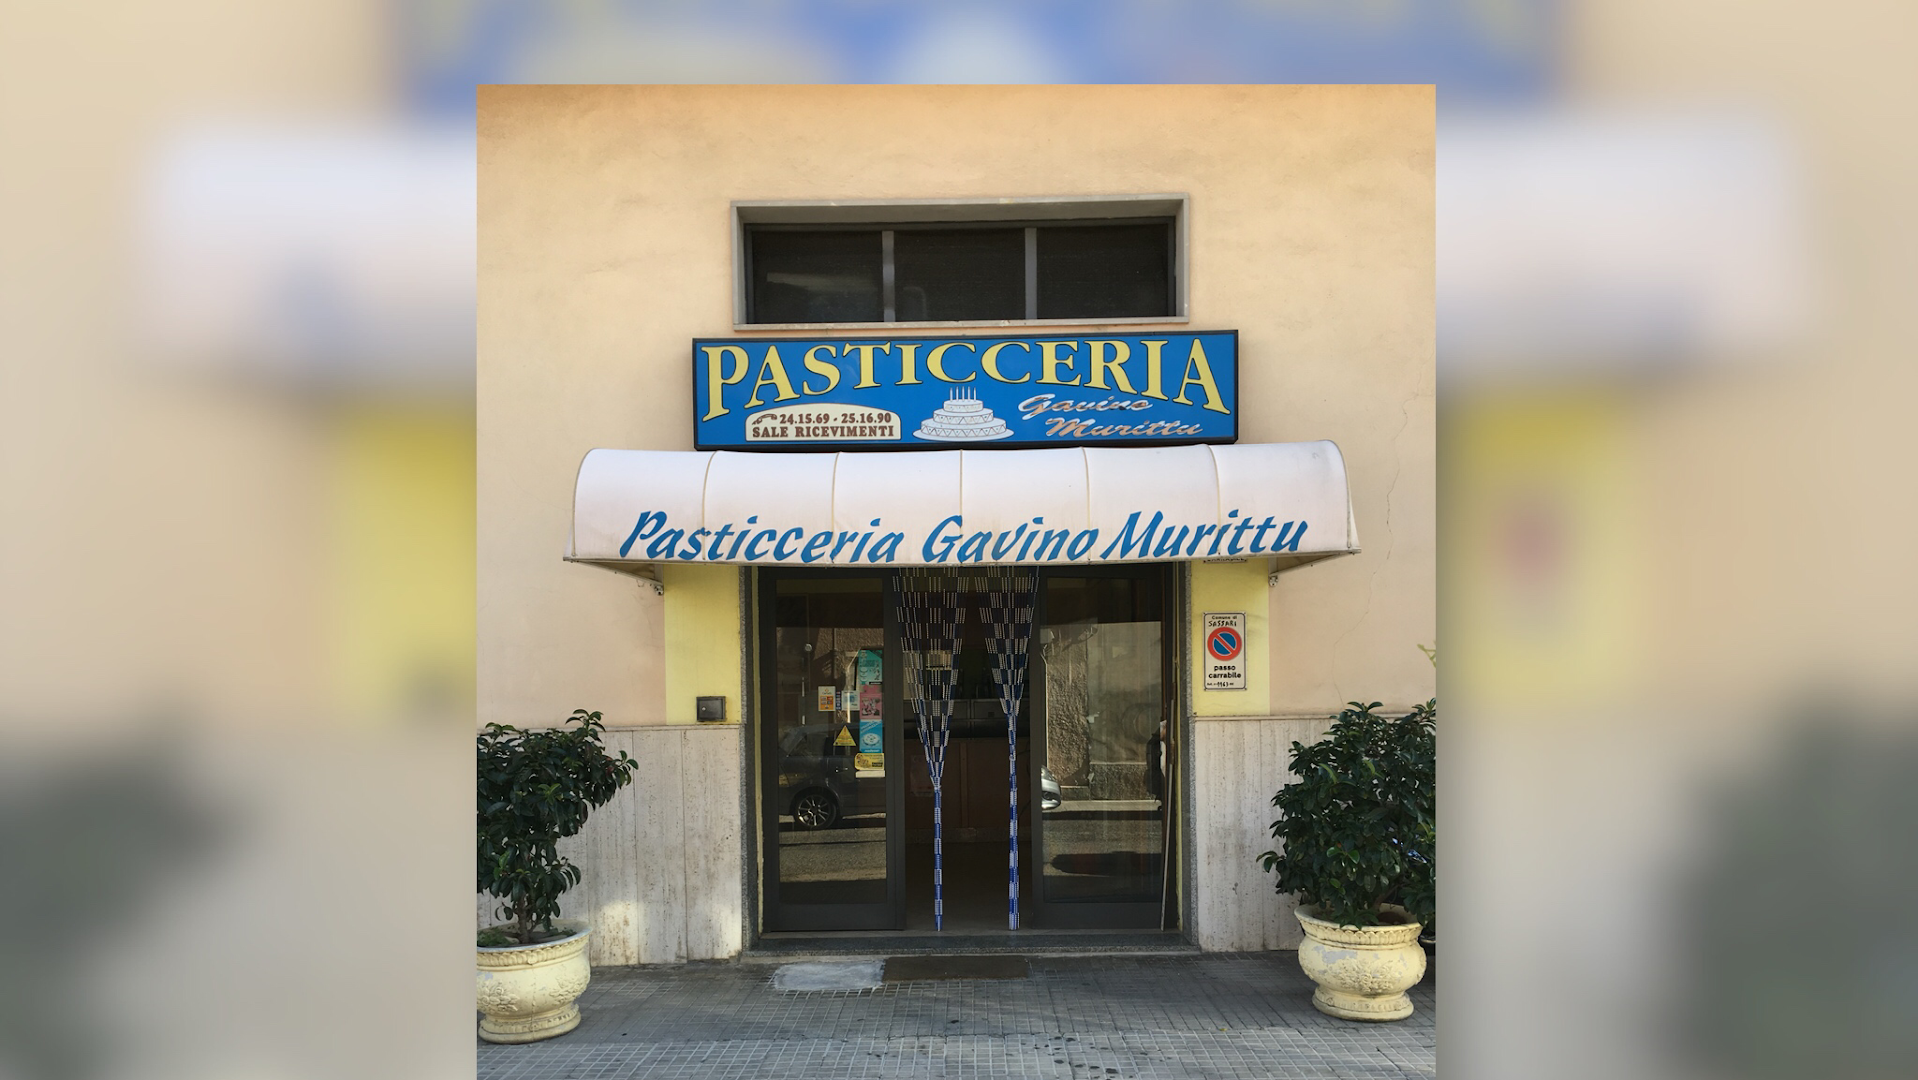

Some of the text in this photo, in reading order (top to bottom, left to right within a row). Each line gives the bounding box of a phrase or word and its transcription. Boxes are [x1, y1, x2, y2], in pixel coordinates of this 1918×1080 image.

[701, 338, 1231, 423] PASTICCERIA
[779, 413, 830, 425] 24.15.69
[841, 412, 892, 424] 25.16.90
[1018, 393, 1154, 421] Gavino
[752, 425, 895, 438] SALE RICEVIMENTI
[1045, 417, 1204, 438] Murittu
[619, 509, 1308, 564] Pasticceria Gavino Murittu
